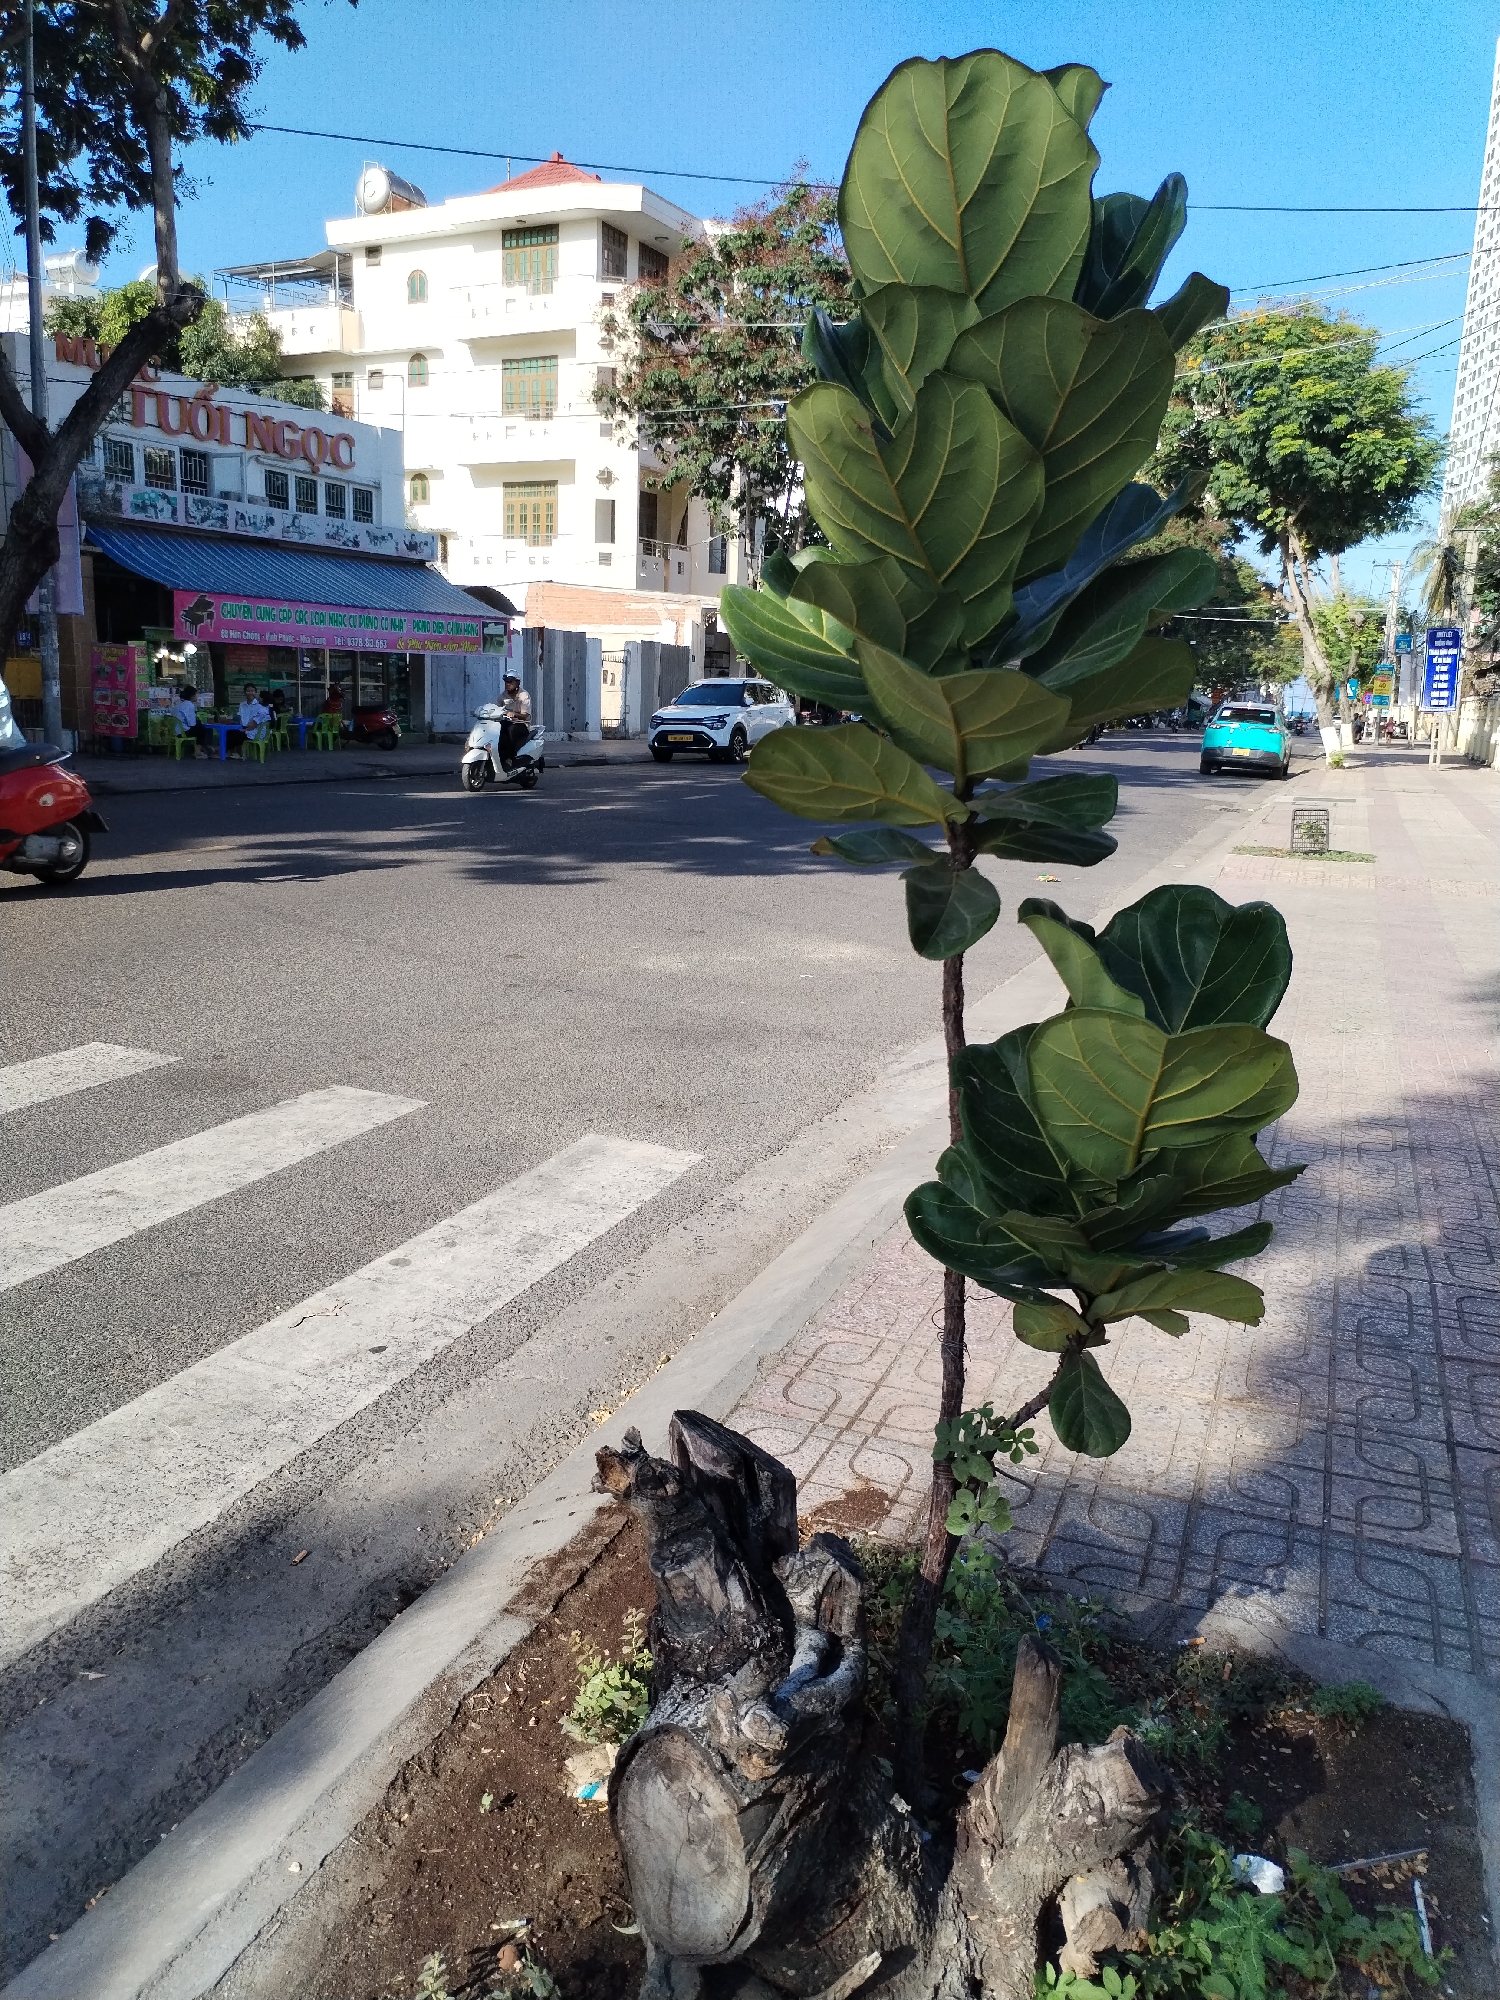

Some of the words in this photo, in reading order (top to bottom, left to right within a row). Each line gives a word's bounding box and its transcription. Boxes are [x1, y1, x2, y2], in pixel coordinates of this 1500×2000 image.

[54, 331, 162, 382] MUC
[127, 382, 233, 447] TUỔI
[245, 410, 356, 474] NGỌC
[220, 600, 253, 621] CHUYÊN
[255, 604, 276, 623] CUNG
[278, 602, 293, 624] CẤP
[294, 604, 308, 625] CÁC
[310, 609, 327, 631] LOẠI
